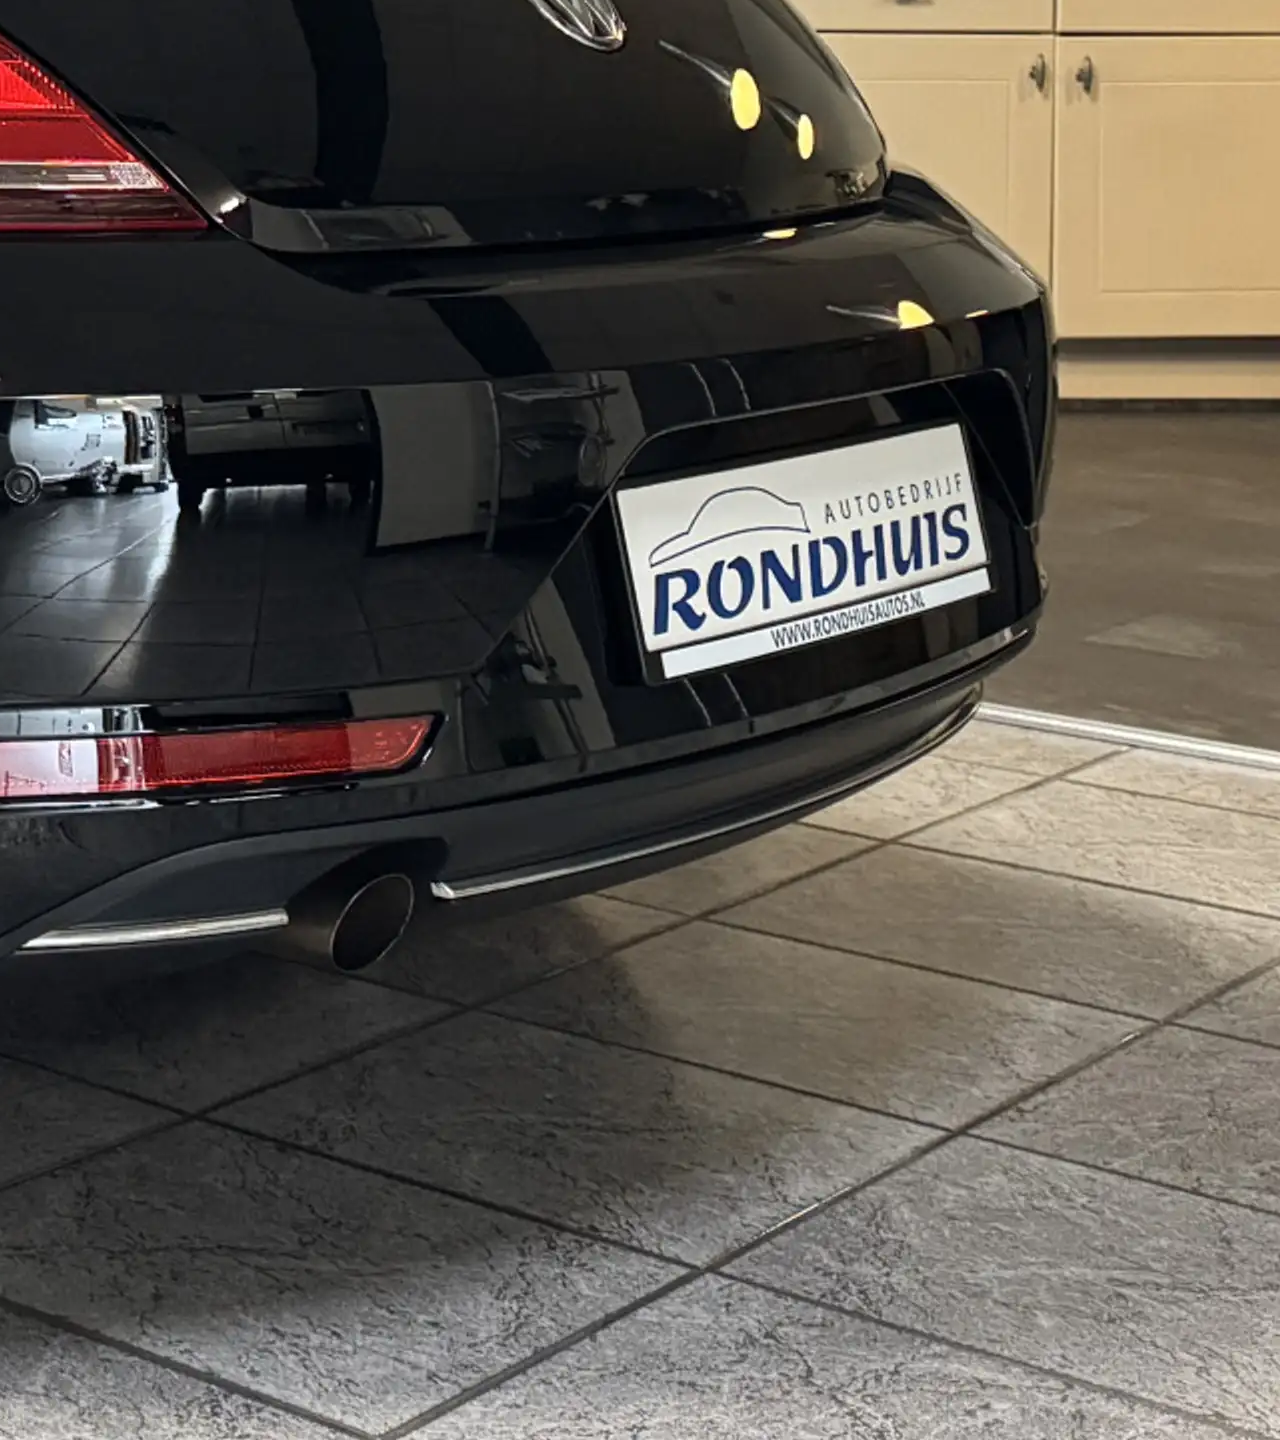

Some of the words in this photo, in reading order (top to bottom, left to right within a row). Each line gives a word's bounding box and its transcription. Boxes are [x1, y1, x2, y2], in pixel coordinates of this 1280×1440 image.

[823, 473, 964, 524] AUTOBEDRIJF
[652, 503, 971, 636] RONDHUIS
[770, 593, 926, 648] WWW.RONDHUISAUTOS.NL
